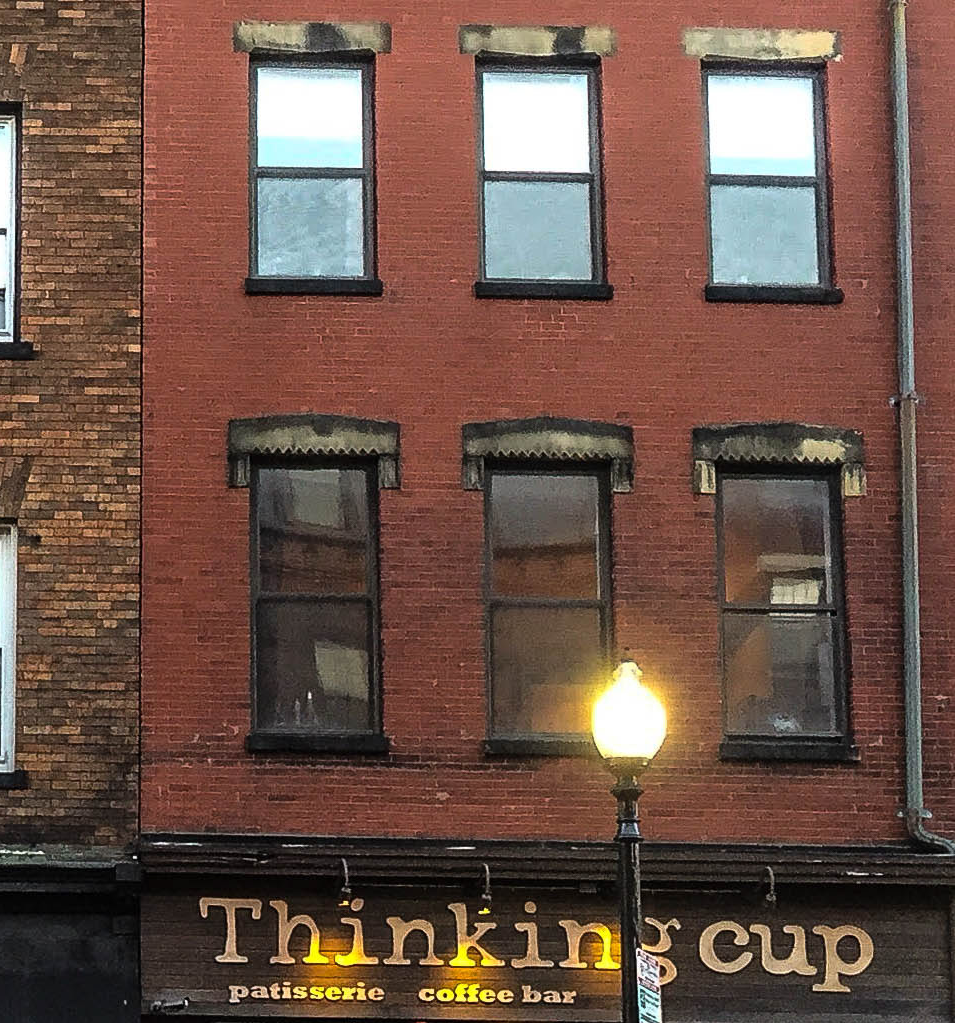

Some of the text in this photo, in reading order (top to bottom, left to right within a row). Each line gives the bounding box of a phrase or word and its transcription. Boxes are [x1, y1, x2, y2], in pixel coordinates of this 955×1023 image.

[199, 897, 874, 992] Thinking cup
[228, 981, 577, 1004] patisserie coffee bar
